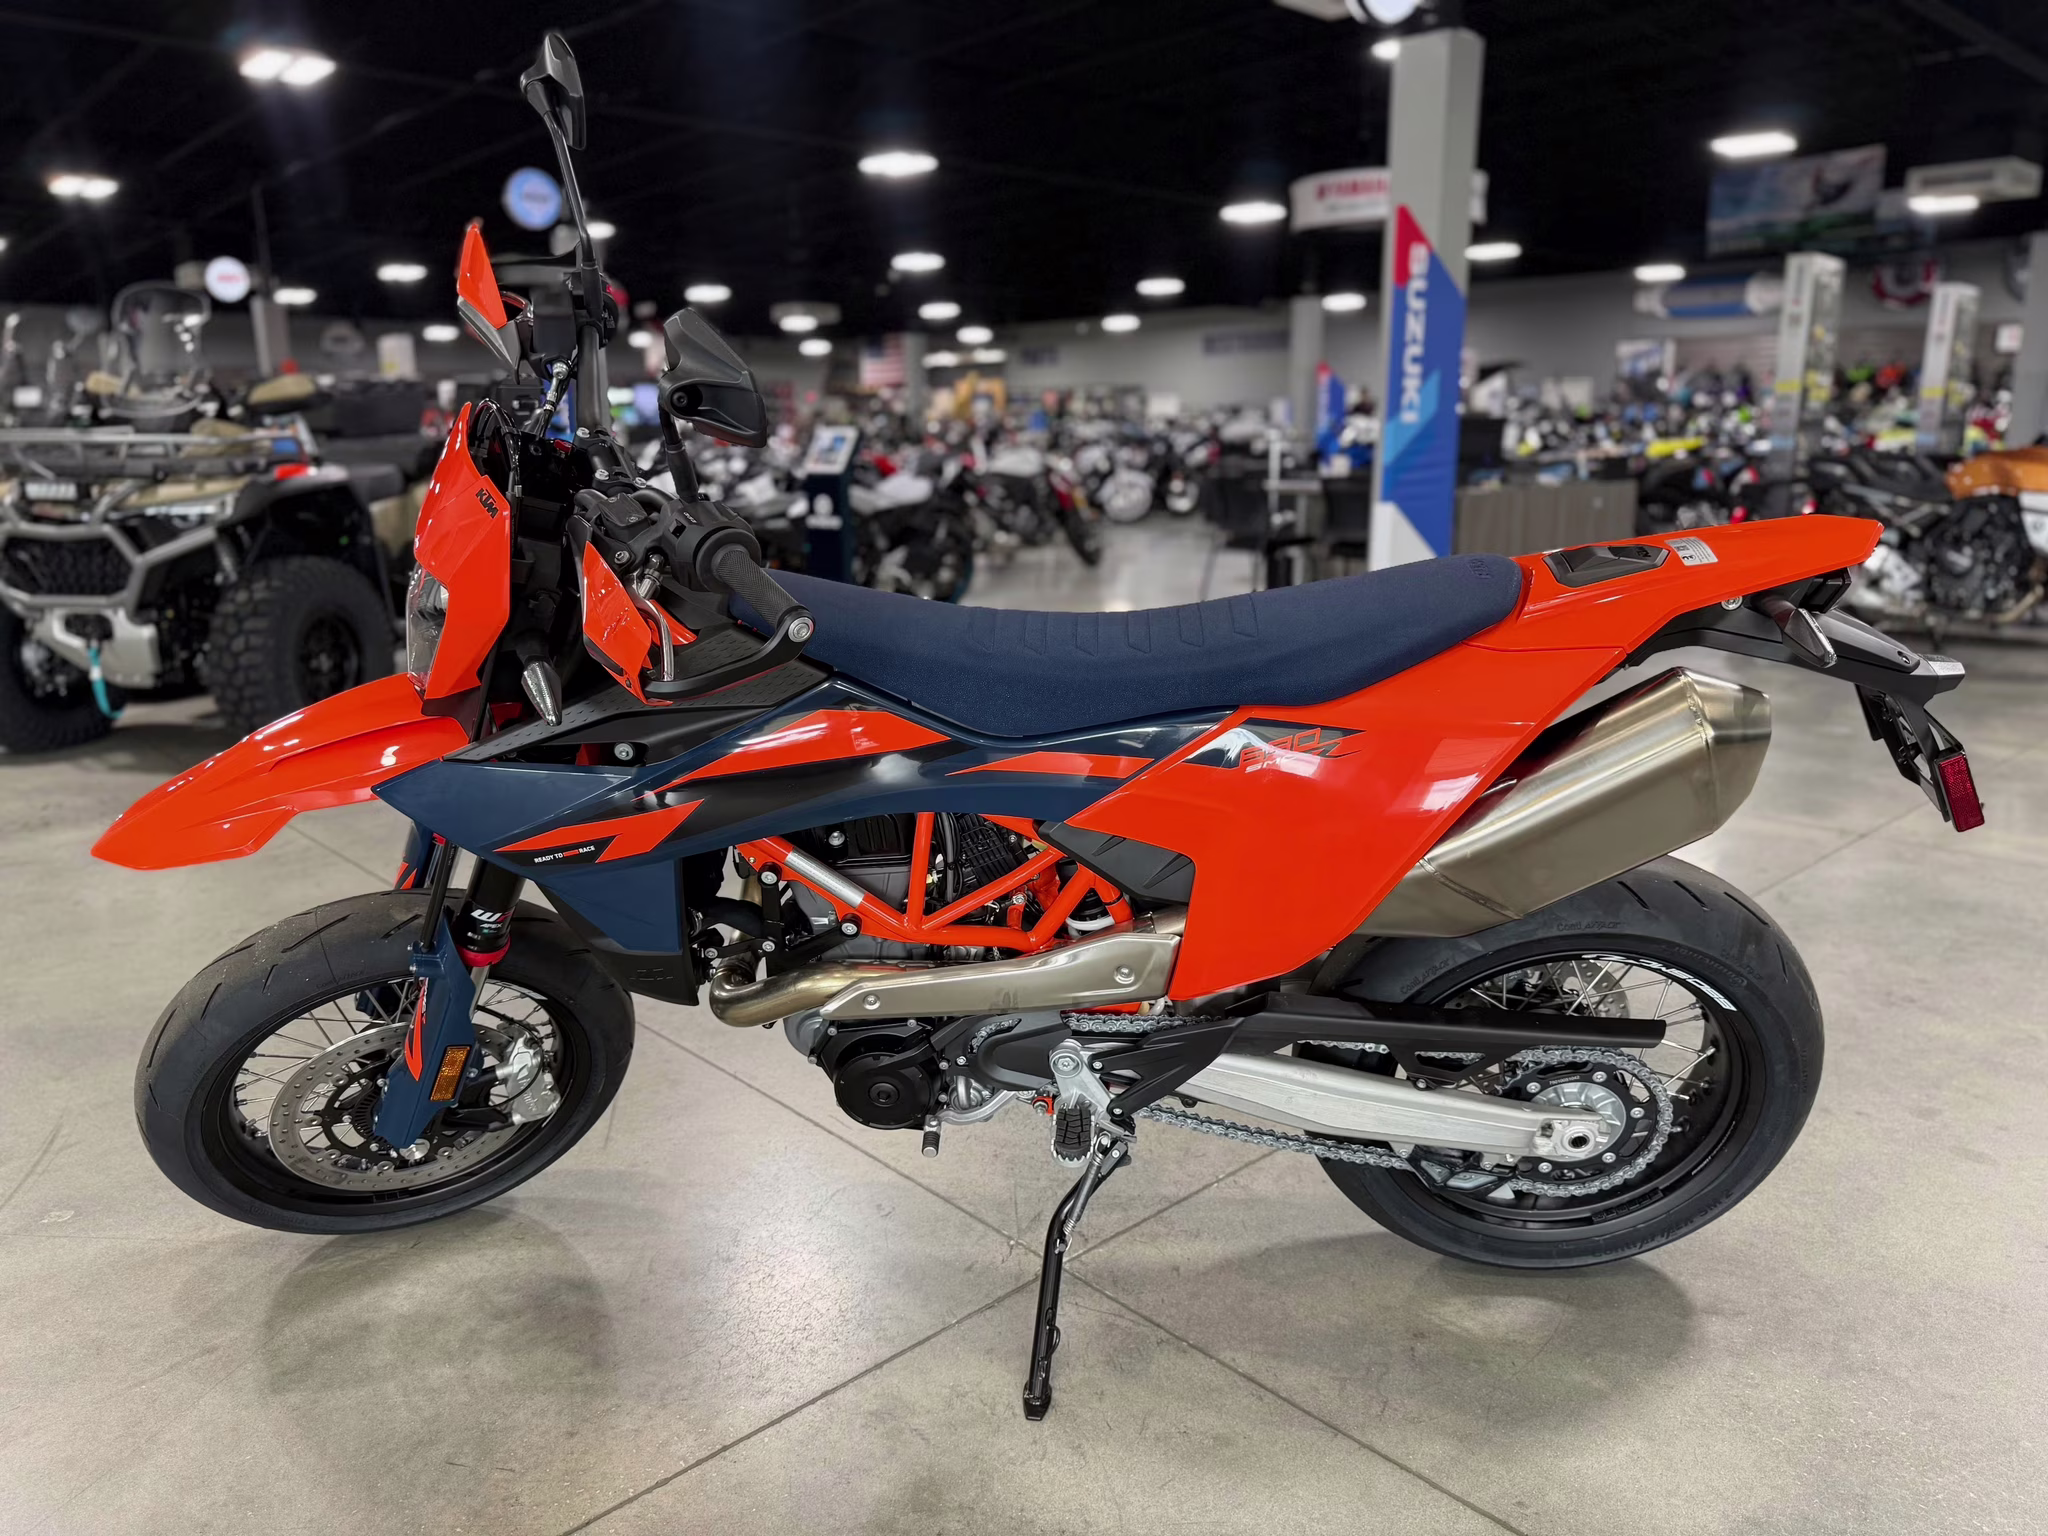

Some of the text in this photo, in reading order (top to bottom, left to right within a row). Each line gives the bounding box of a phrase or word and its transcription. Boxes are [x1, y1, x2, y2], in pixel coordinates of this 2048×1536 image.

[1400, 241, 1429, 423] SUZUKI
[475, 487, 499, 519] KTM
[533, 855, 554, 863] READY
[578, 845, 595, 854] RACE
